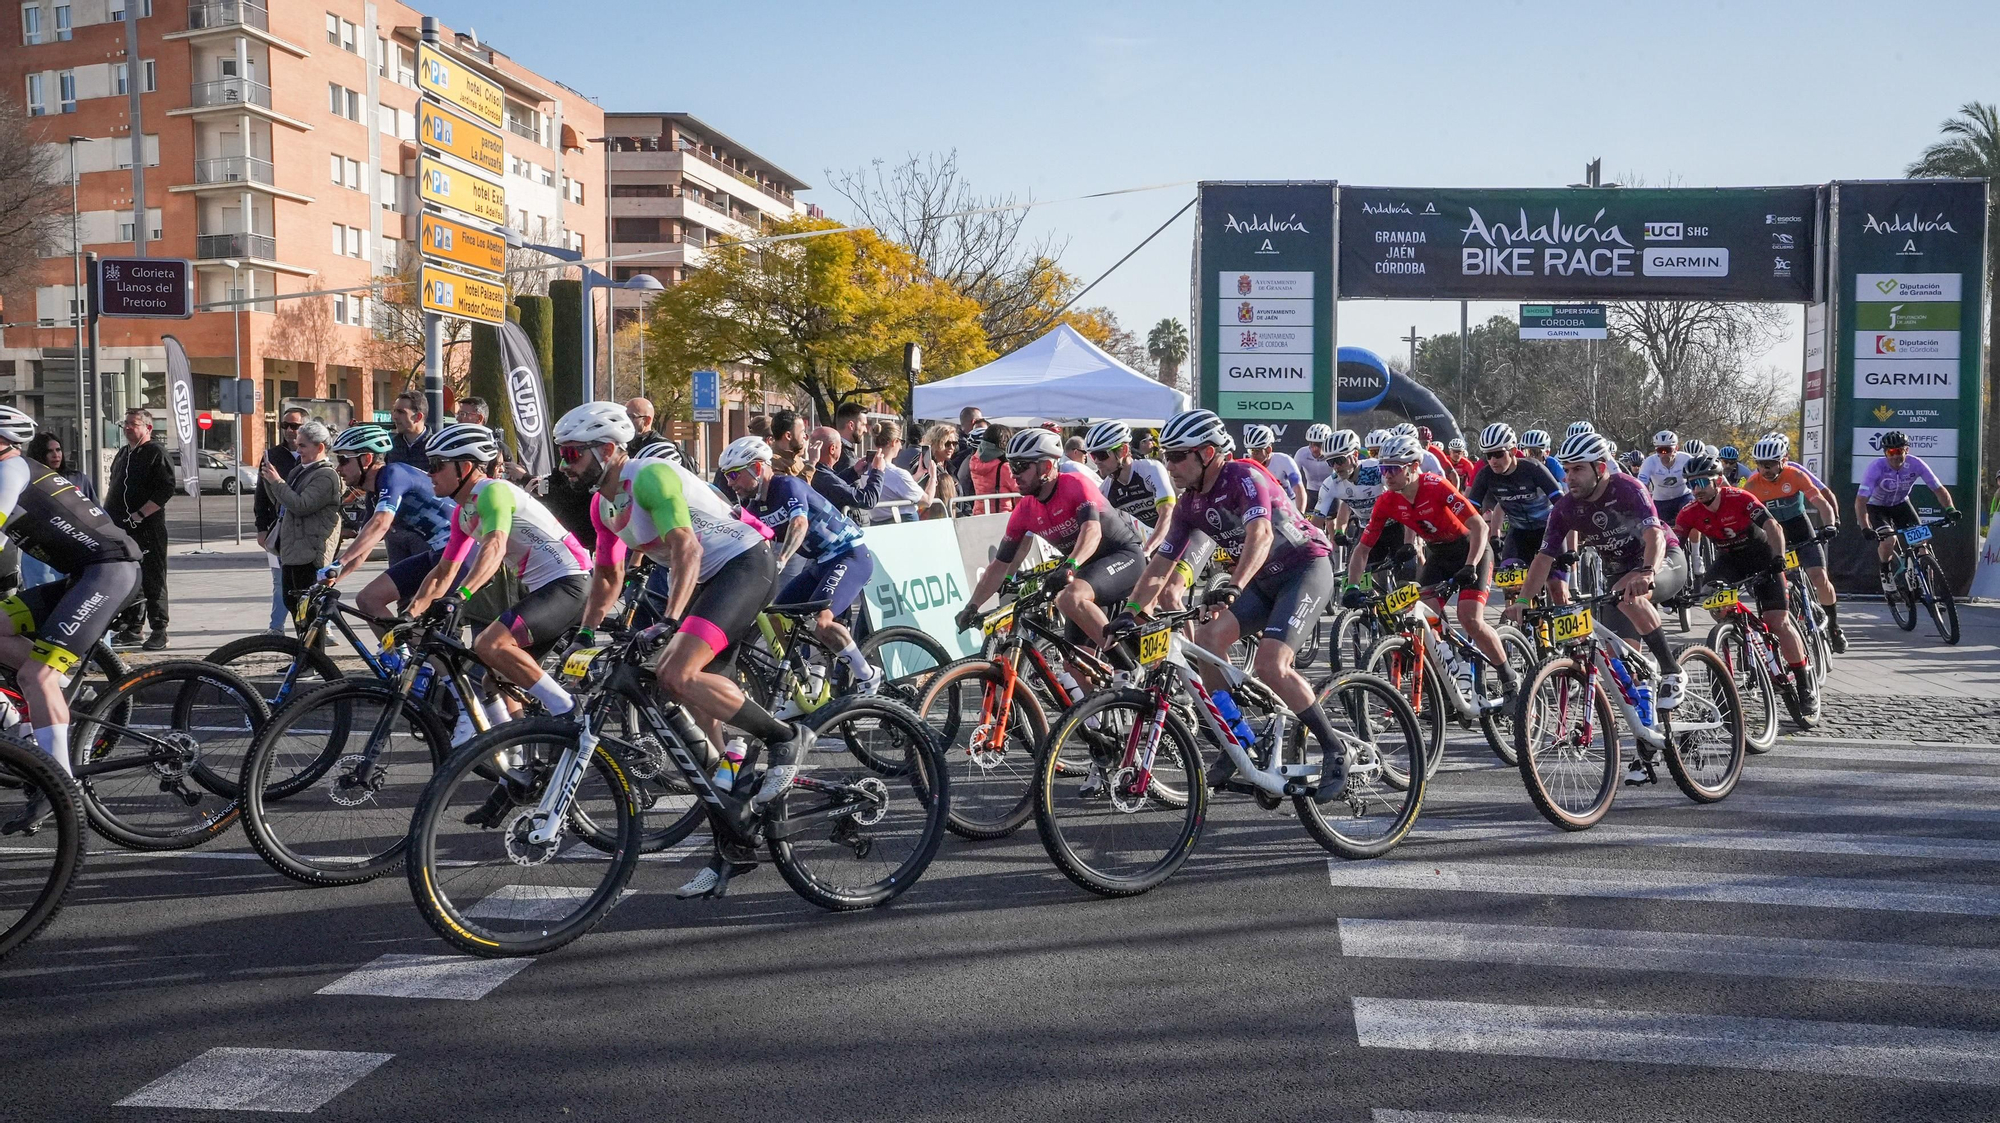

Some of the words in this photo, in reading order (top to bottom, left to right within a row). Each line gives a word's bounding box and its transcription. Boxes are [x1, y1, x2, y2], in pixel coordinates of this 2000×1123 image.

[466, 77, 482, 97] hotel
[485, 87, 502, 108] Crisol
[460, 92, 477, 109] Jardines
[478, 103, 484, 113] de
[481, 137, 502, 153] parador
[471, 146, 478, 160] La
[480, 151, 502, 170] Arruzafa
[473, 182, 490, 203] hotel
[492, 189, 503, 206] Exe
[474, 201, 483, 213] Las
[486, 204, 503, 220] Adelfas
[1362, 202, 1413, 215] Andalucía
[1224, 212, 1310, 234] Andalucía
[1460, 206, 1634, 247] Andalucía
[1862, 212, 1958, 234] Andalucía
[1375, 231, 1427, 243] GRANADA
[1650, 225, 1680, 237] UCI
[1687, 226, 1709, 237] SHC
[462, 231, 476, 247] Finca
[476, 237, 486, 249] Los
[486, 241, 503, 254] Abetos
[1386, 244, 1415, 259] JAÉN
[490, 255, 503, 267] hotel
[1375, 259, 1426, 275] CÓRDOBA
[1462, 248, 1534, 276] BIKE
[1544, 248, 1635, 277] RACE
[1653, 256, 1719, 267] GARMIN
[131, 267, 175, 278] Glorieta
[116, 282, 152, 292] Llanos
[155, 283, 173, 293] del
[464, 281, 480, 297] hotel
[480, 285, 503, 303] Palacete
[1900, 283, 1940, 291] Diputación
[123, 297, 167, 308] Pretorio
[458, 298, 480, 314] Mirador
[481, 302, 503, 319] Córdoba
[1899, 339, 1939, 347] Diputación
[1229, 366, 1303, 379] GARMIN
[1865, 373, 1949, 385] GARMIN
[1338, 377, 1379, 387] RMIN
[49, 516, 100, 551] CARL-ZONE
[1220, 526, 1245, 540] BIKES
[1602, 525, 1627, 538] BIKES
[1906, 527, 1930, 542] 520-2
[1498, 571, 1524, 583] 336-1
[1390, 584, 1417, 609] 316-2
[1557, 612, 1589, 637] 304-1
[1143, 631, 1168, 659] 304-2
[595, 745, 631, 793] SCORPION
[827, 803, 860, 818] SCOTT
